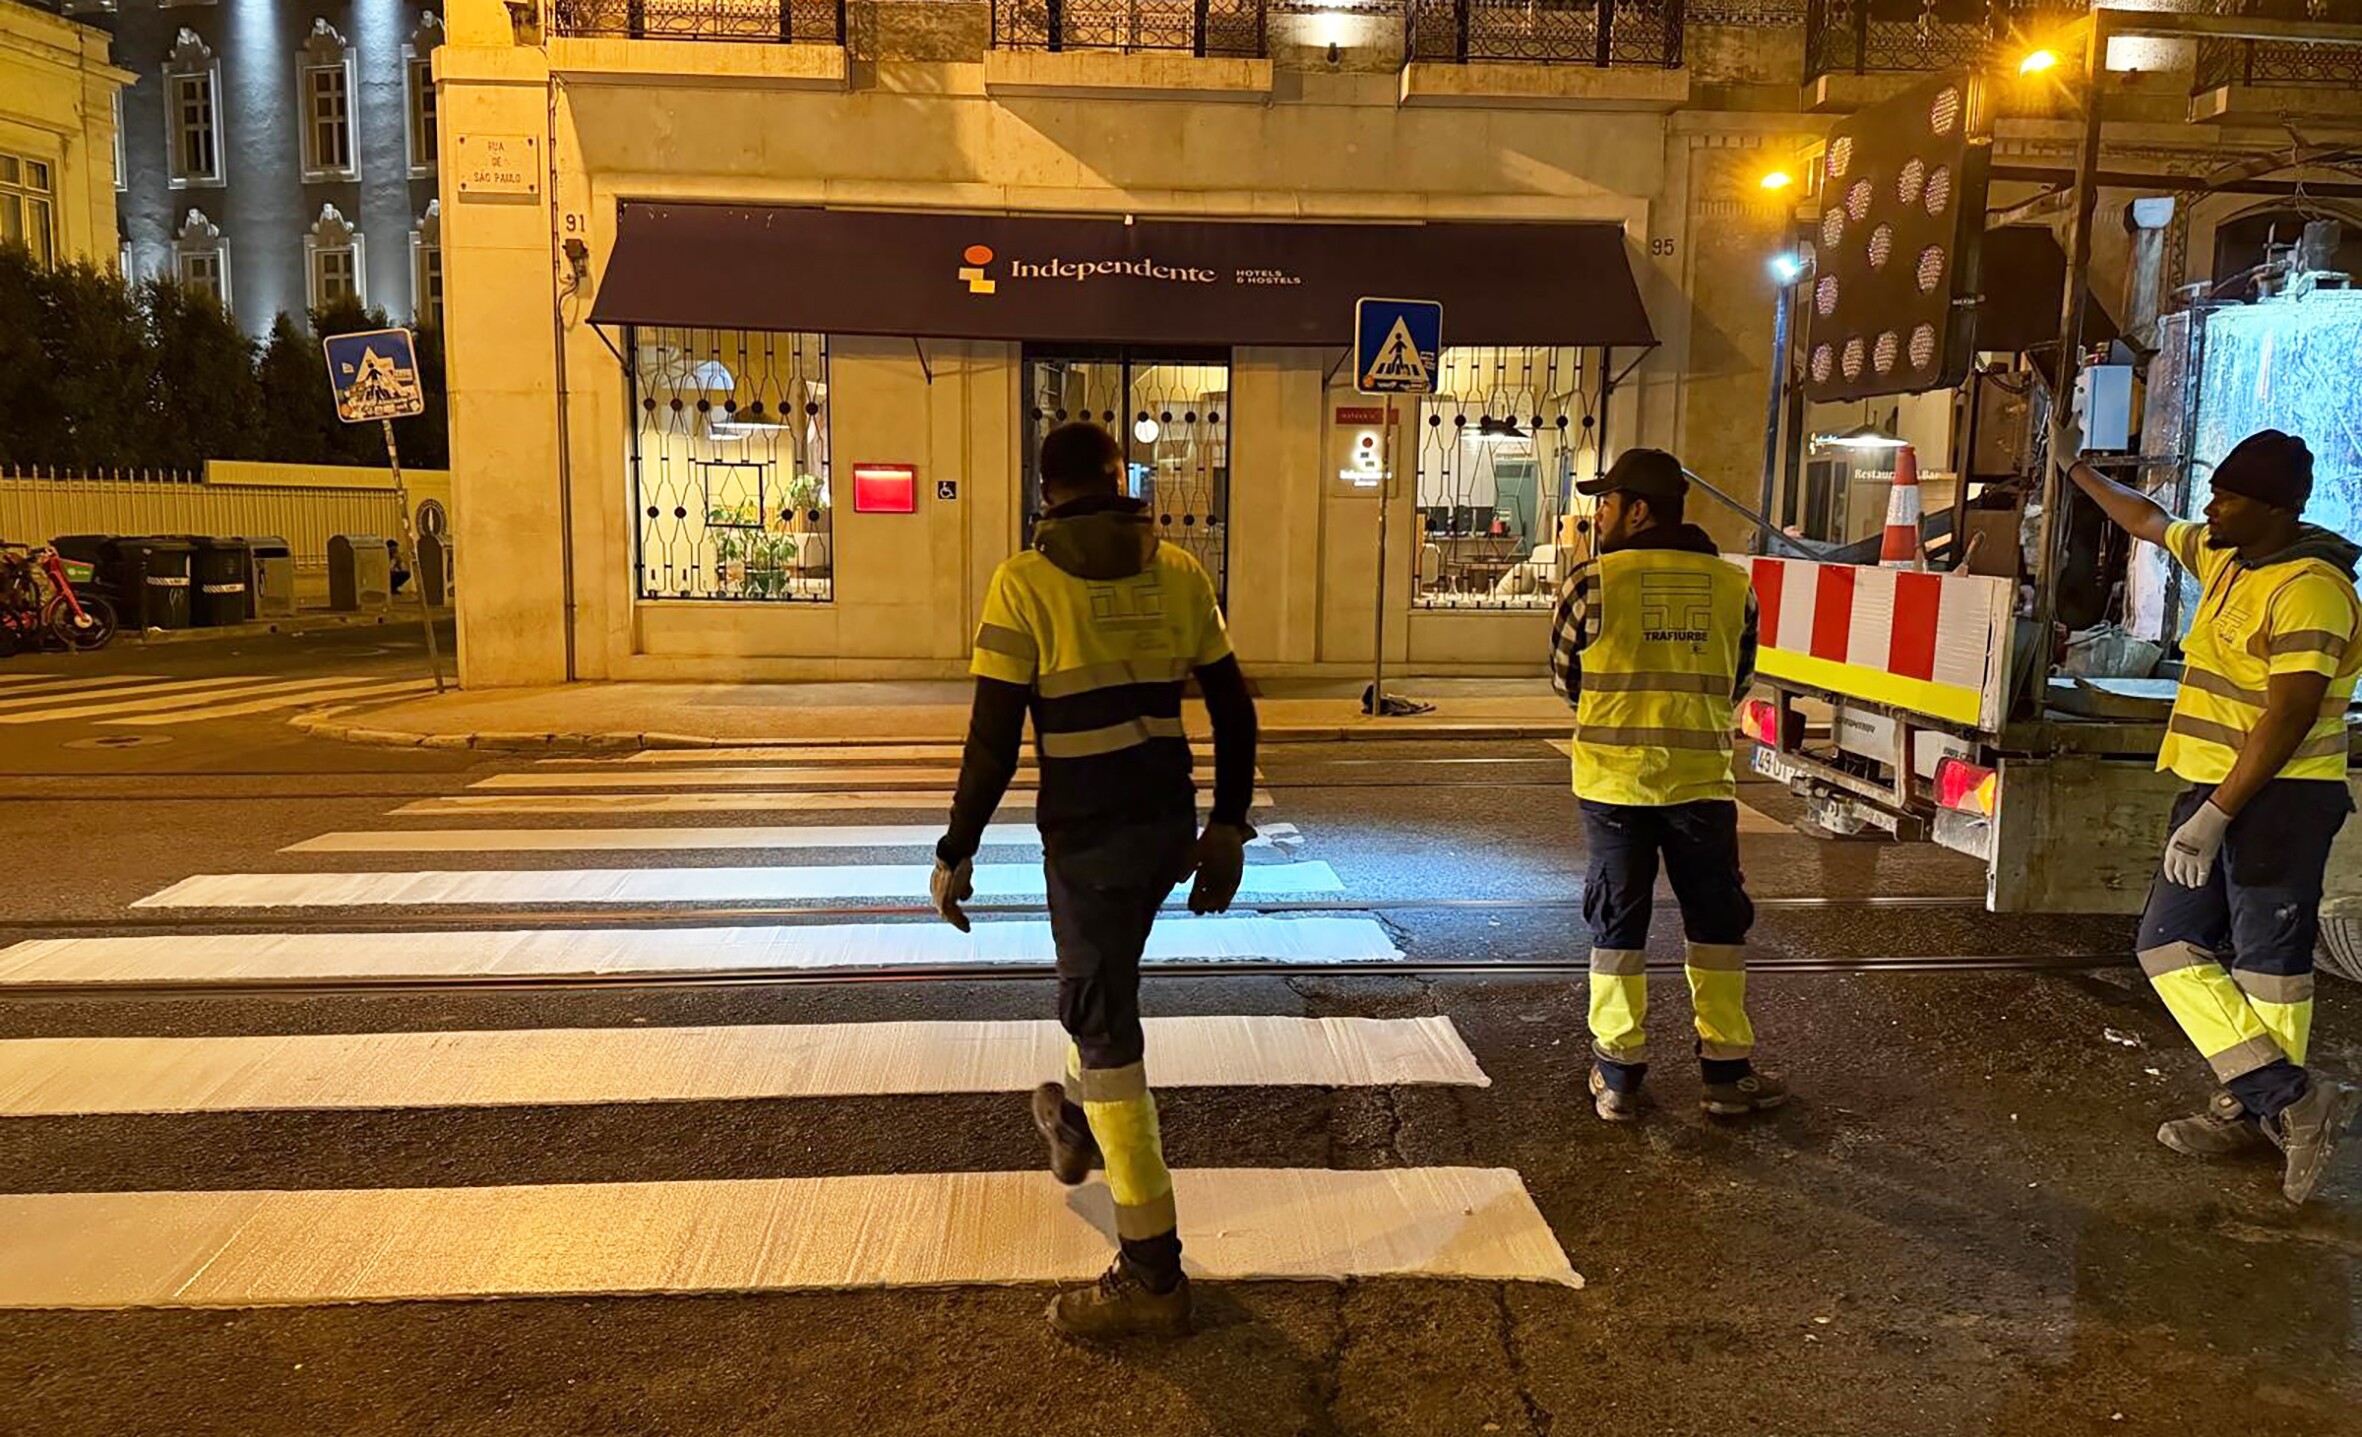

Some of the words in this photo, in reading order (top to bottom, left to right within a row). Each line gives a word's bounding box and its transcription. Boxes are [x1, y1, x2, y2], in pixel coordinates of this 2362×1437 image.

[488, 141, 504, 151] RUA
[495, 173, 520, 183] PAULO
[566, 214, 585, 232] 91
[1652, 239, 1674, 256] 95
[1012, 258, 1217, 281] Independente
[1236, 269, 1282, 277] HOTELS
[1854, 468, 1895, 479] Restaur
[1644, 631, 1708, 641] TRAFIURBE
